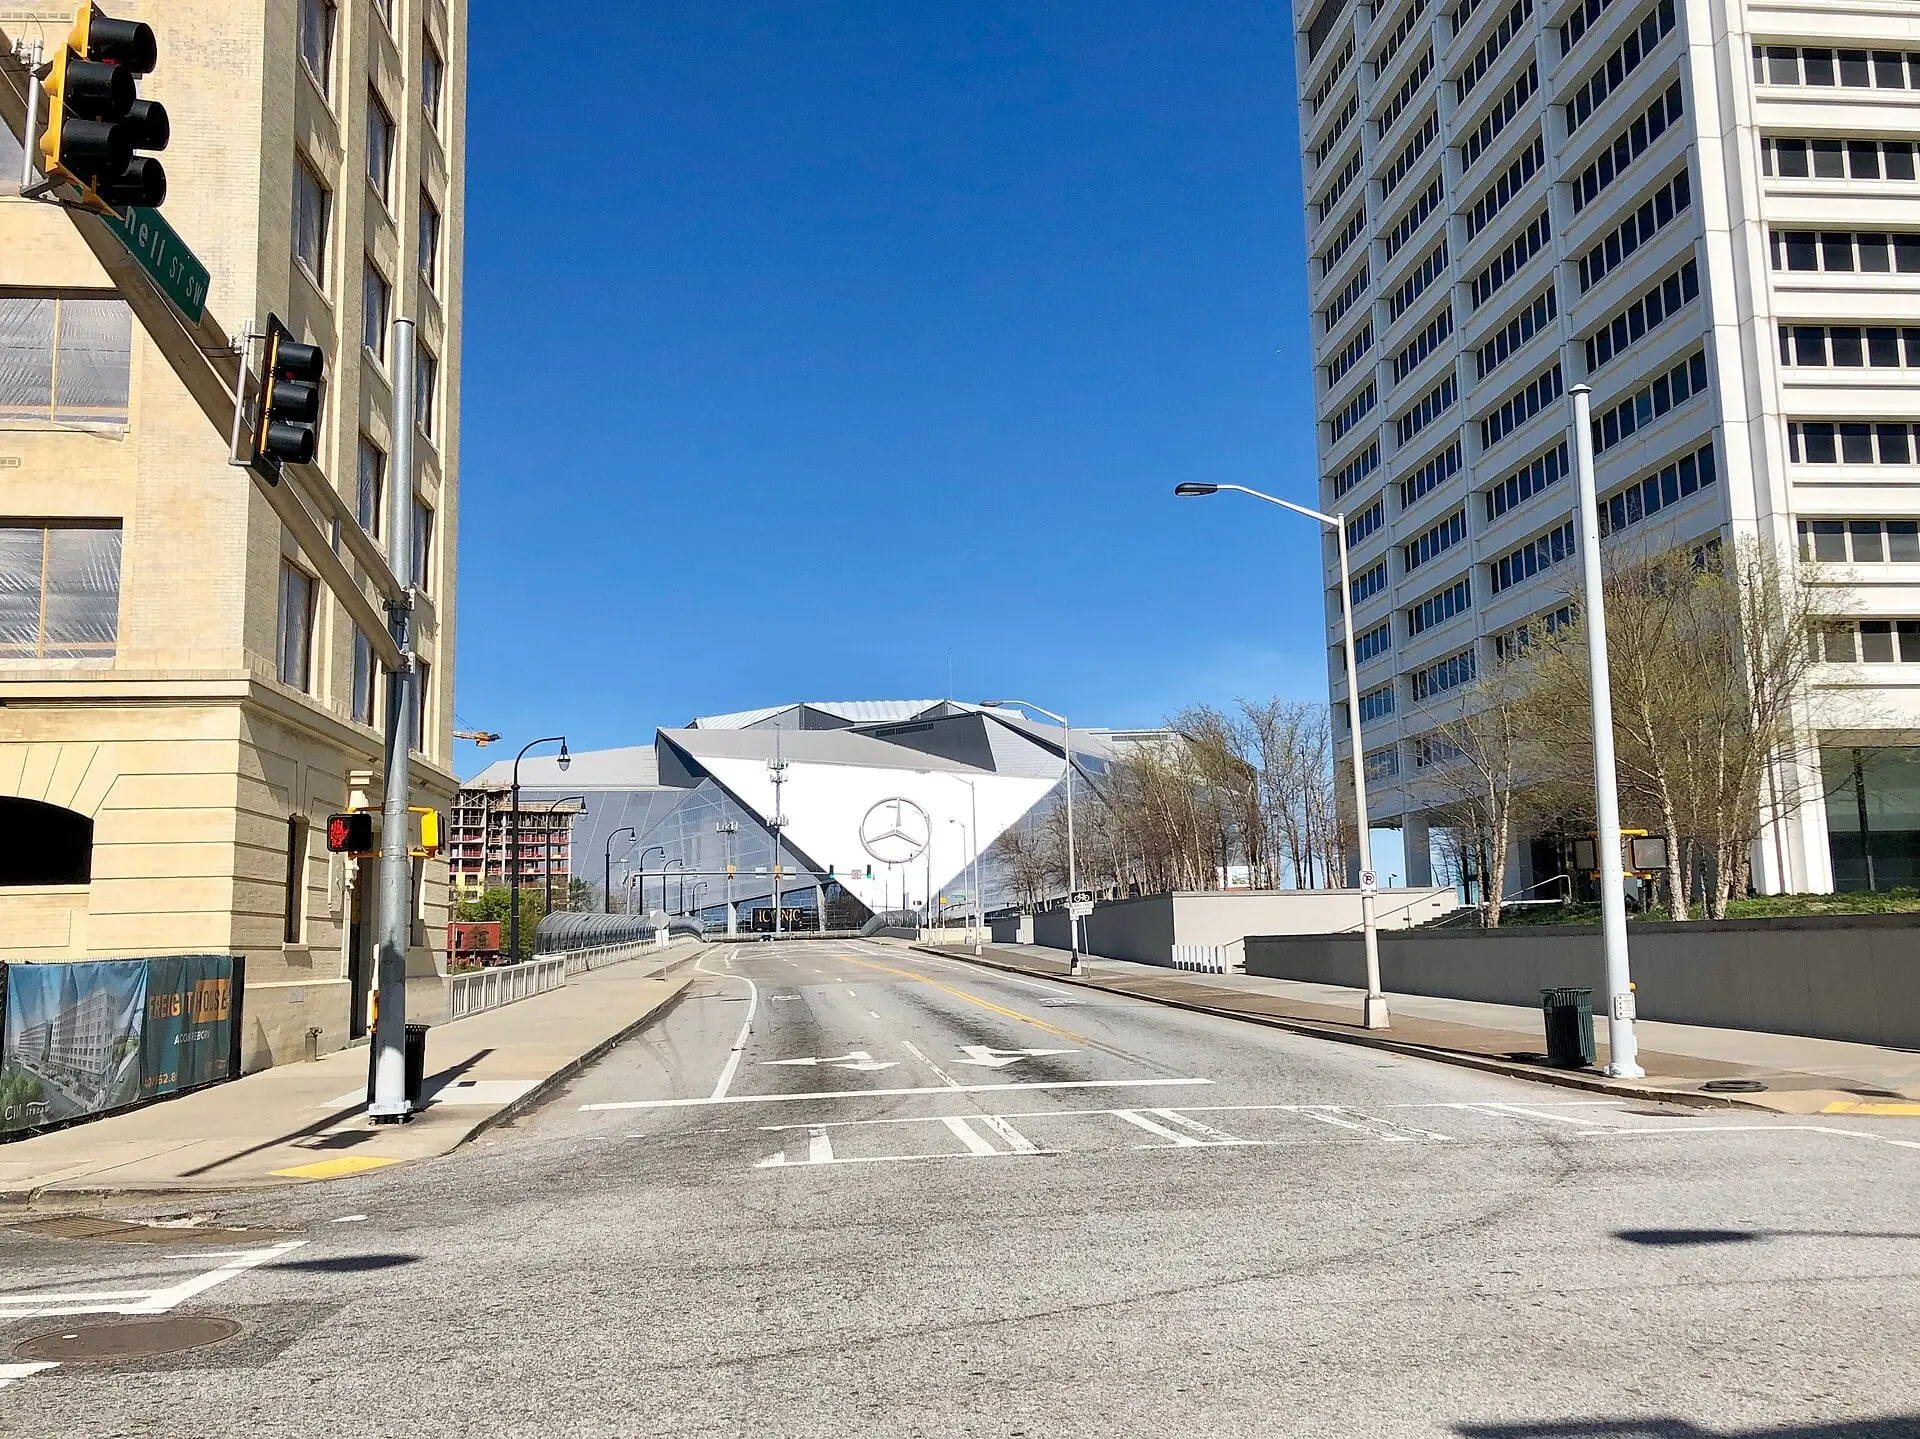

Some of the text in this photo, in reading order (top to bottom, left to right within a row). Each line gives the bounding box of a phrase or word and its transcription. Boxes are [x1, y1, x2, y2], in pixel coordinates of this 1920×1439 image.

[169, 256, 185, 285] ST
[186, 276, 203, 307] SW
[758, 909, 801, 922] ICNIC
